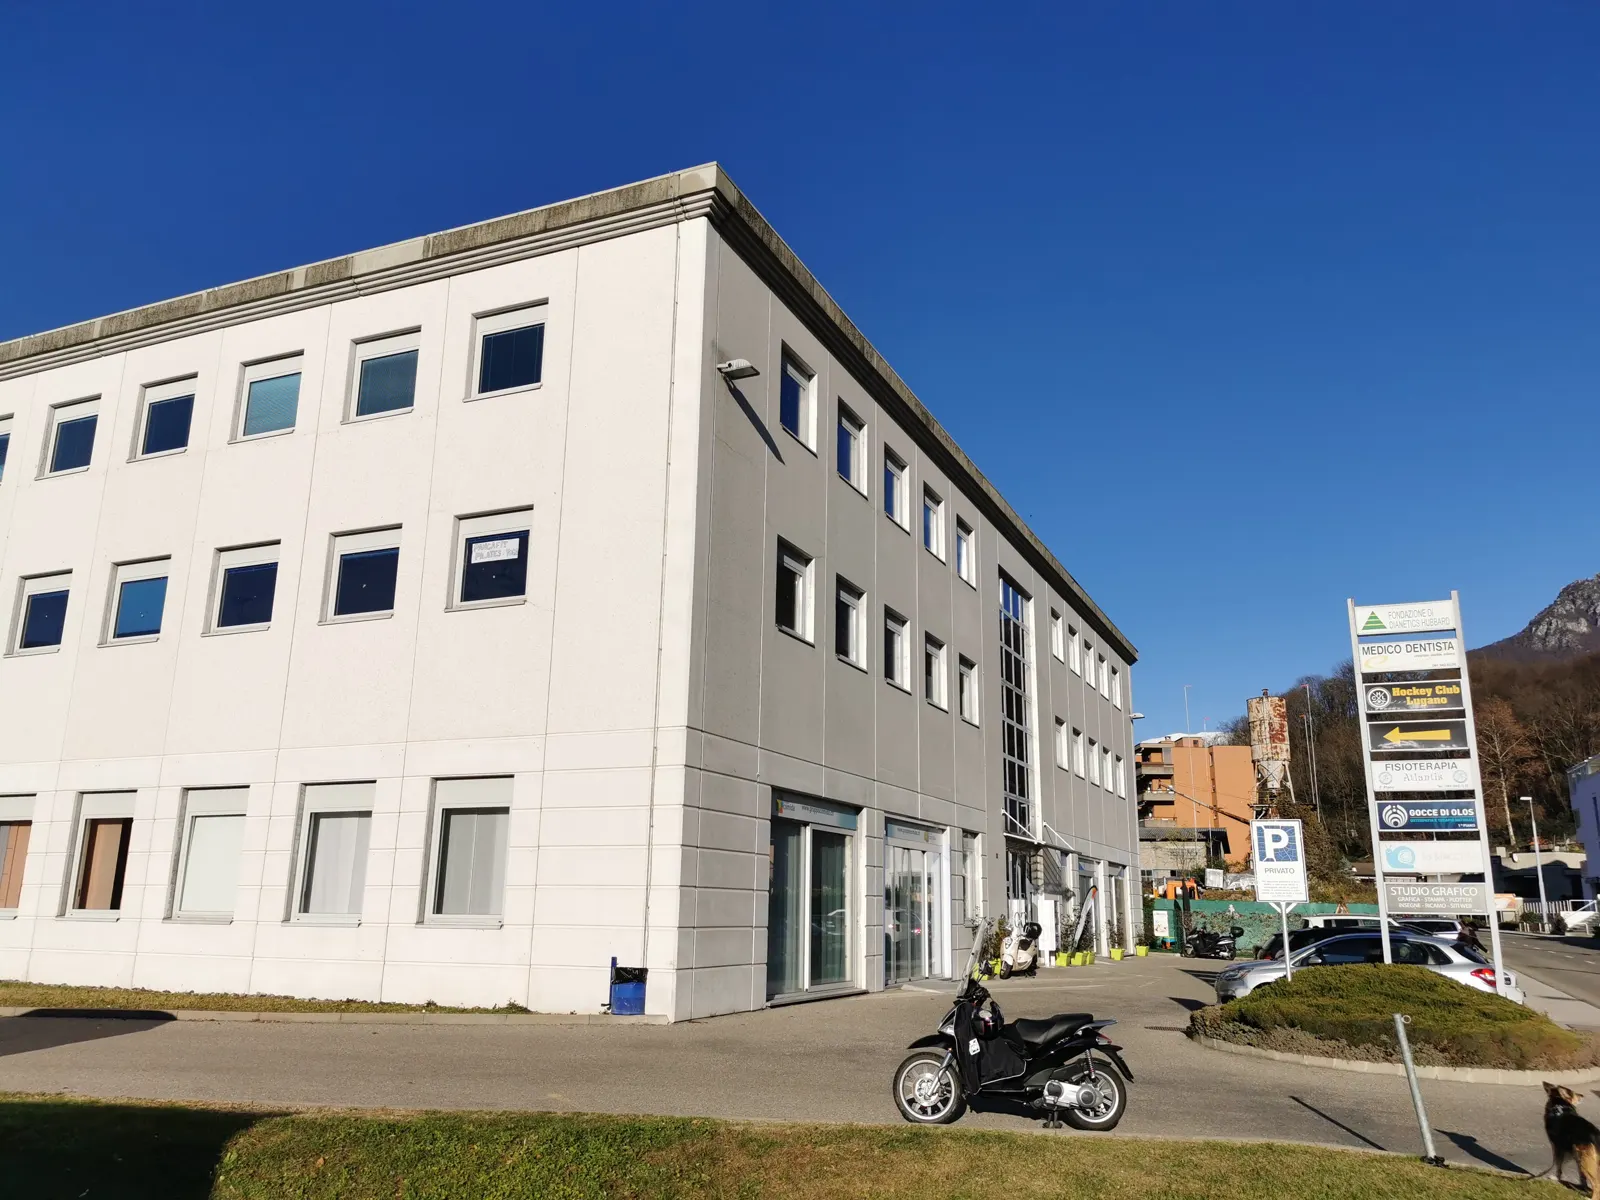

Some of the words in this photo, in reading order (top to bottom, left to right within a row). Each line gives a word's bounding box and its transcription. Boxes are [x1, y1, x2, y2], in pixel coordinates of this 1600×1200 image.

[1388, 609, 1426, 620] FONDAZIONE
[1427, 608, 1434, 617] DI
[1388, 619, 1420, 630] DIANETICS
[1421, 616, 1451, 627] HUBBARD
[1362, 644, 1402, 656] MEDICO
[1405, 641, 1455, 654] DENTISTA
[1391, 686, 1433, 697] Hockey
[1435, 684, 1461, 695] Club
[1405, 696, 1448, 707] Lugano
[1385, 762, 1458, 772] FISIOTERAPIA
[1403, 772, 1444, 782] Atlantis
[1409, 808, 1439, 817] GOCCE
[1440, 808, 1450, 816] DI
[1450, 808, 1475, 816] OLOS
[1264, 828, 1289, 859] P
[1390, 886, 1430, 896] STUDIO
[1431, 886, 1478, 896] GRAFICO
